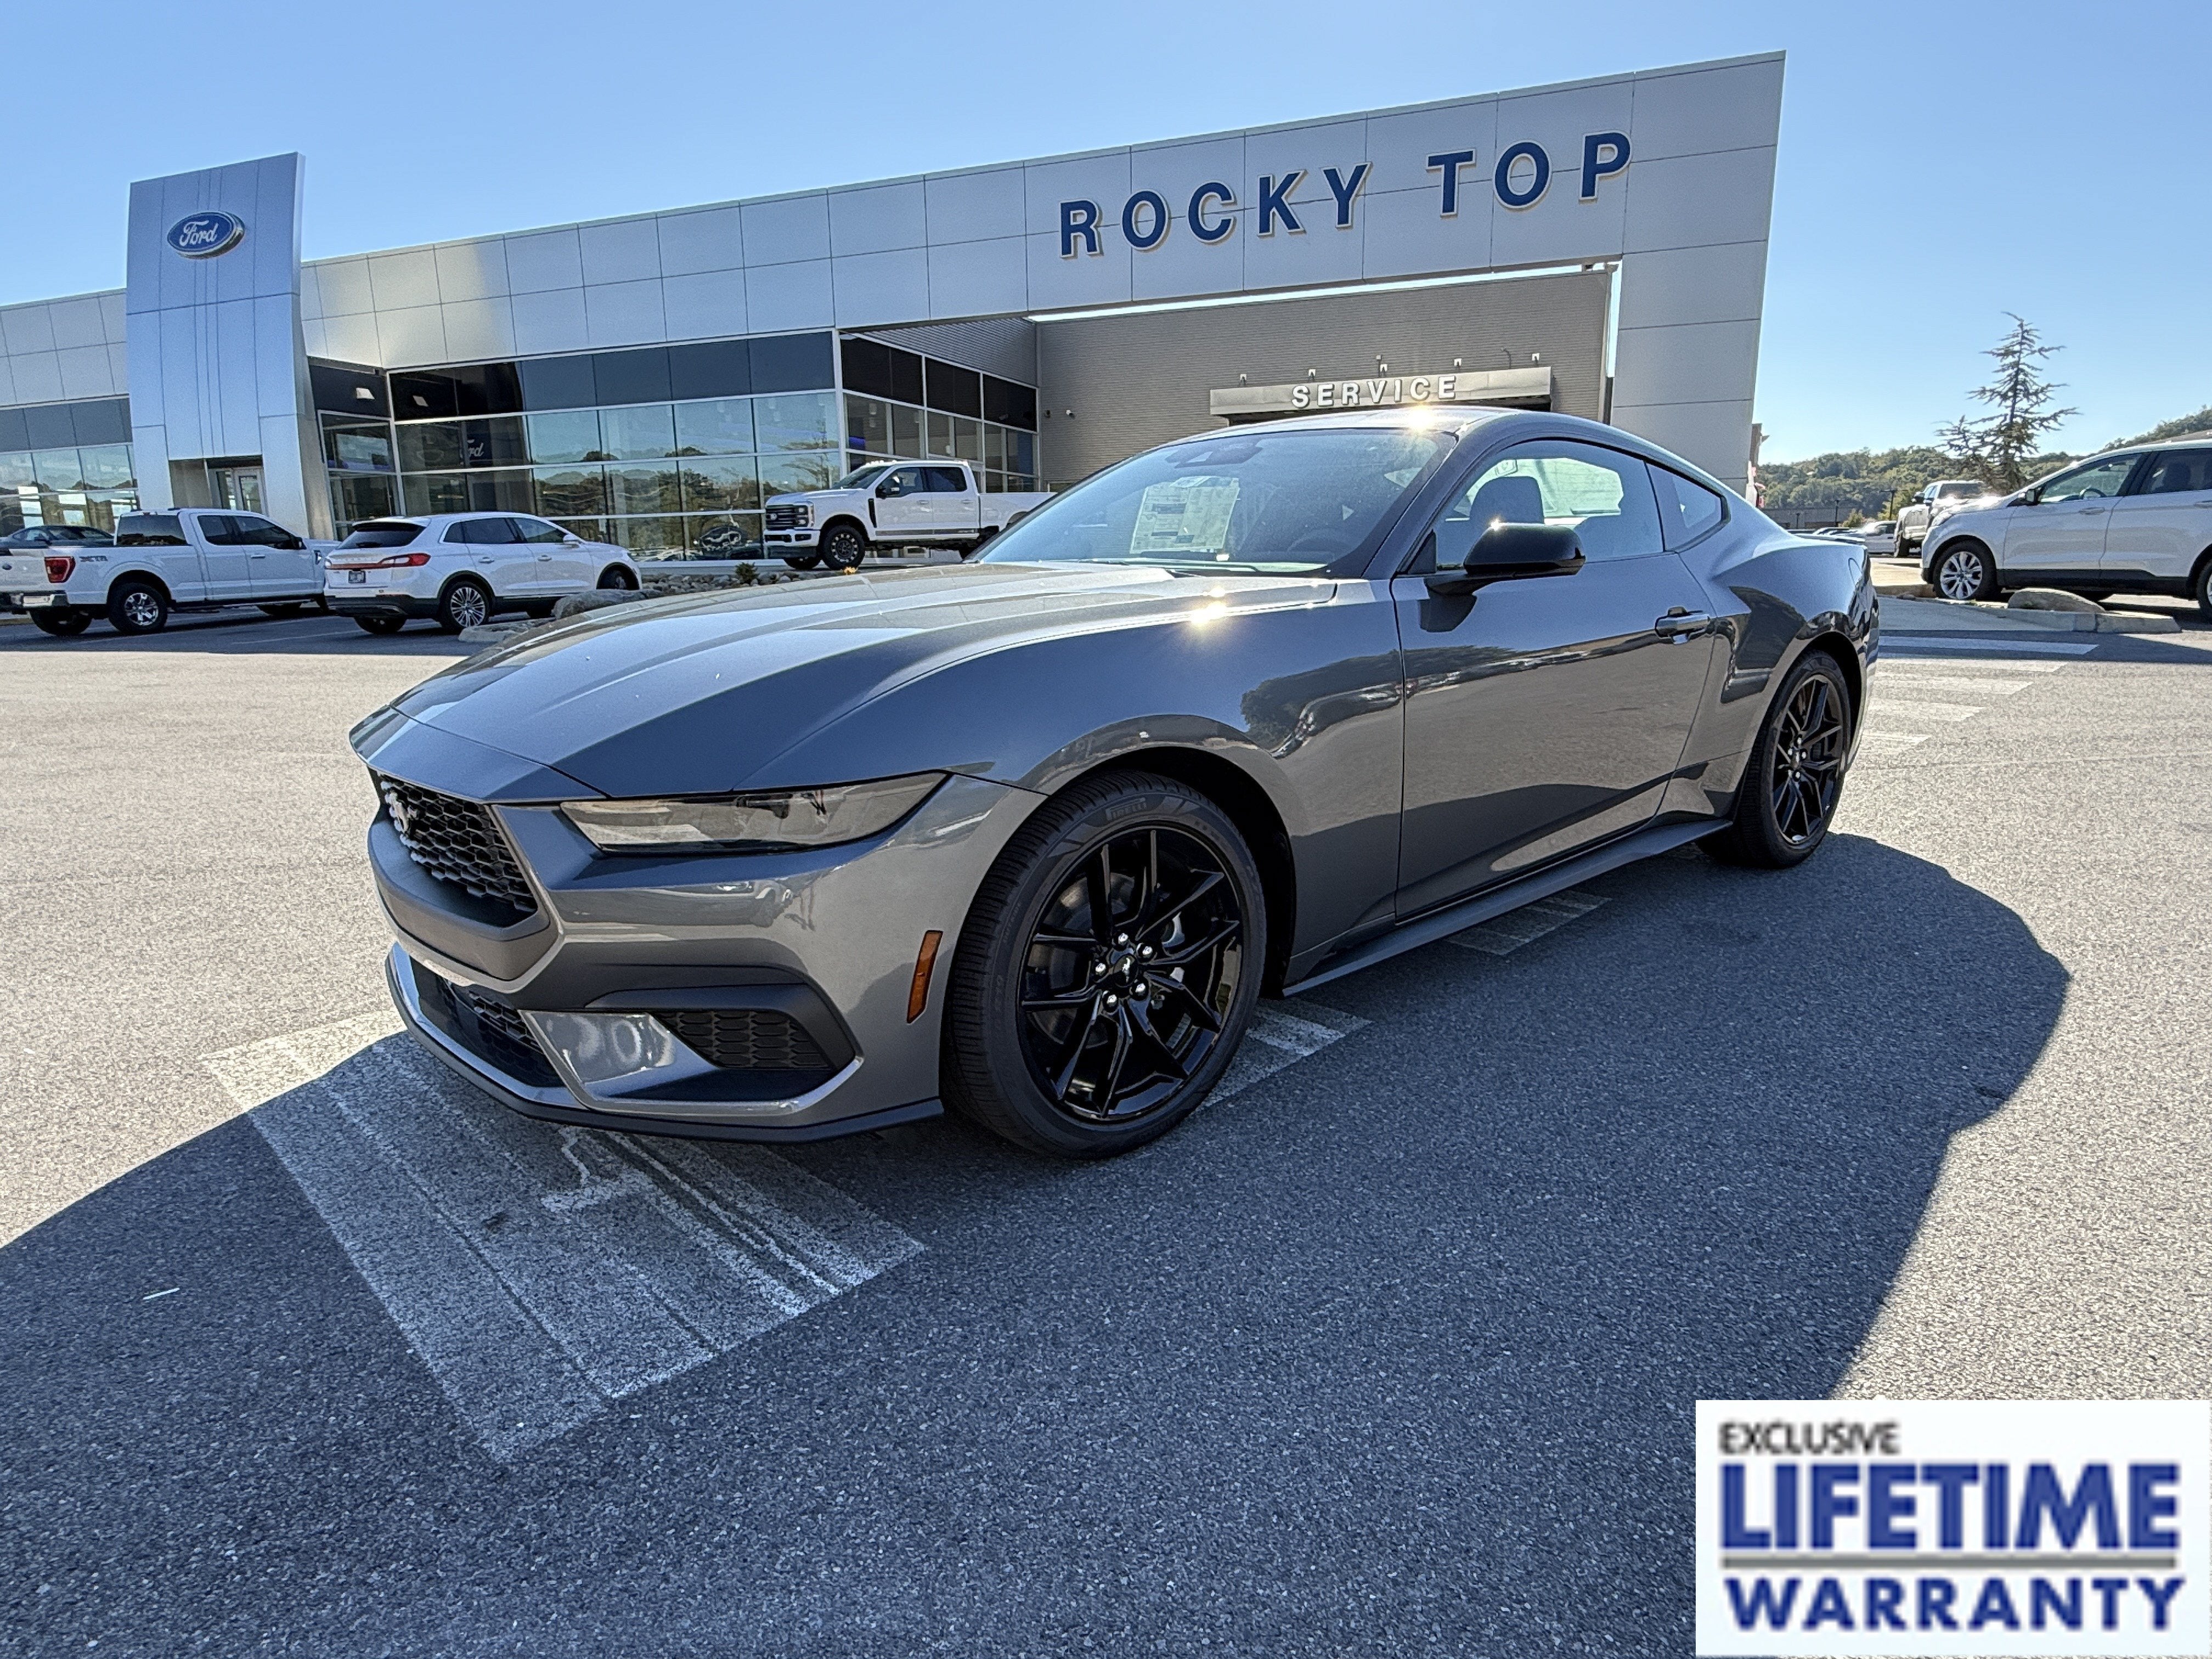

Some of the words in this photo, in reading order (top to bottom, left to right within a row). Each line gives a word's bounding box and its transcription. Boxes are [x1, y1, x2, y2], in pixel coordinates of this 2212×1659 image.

[1059, 162, 1370, 257] ROCKY
[1427, 131, 1632, 215] TOP
[179, 220, 218, 246] Ford
[1291, 375, 1456, 409] SERVICE
